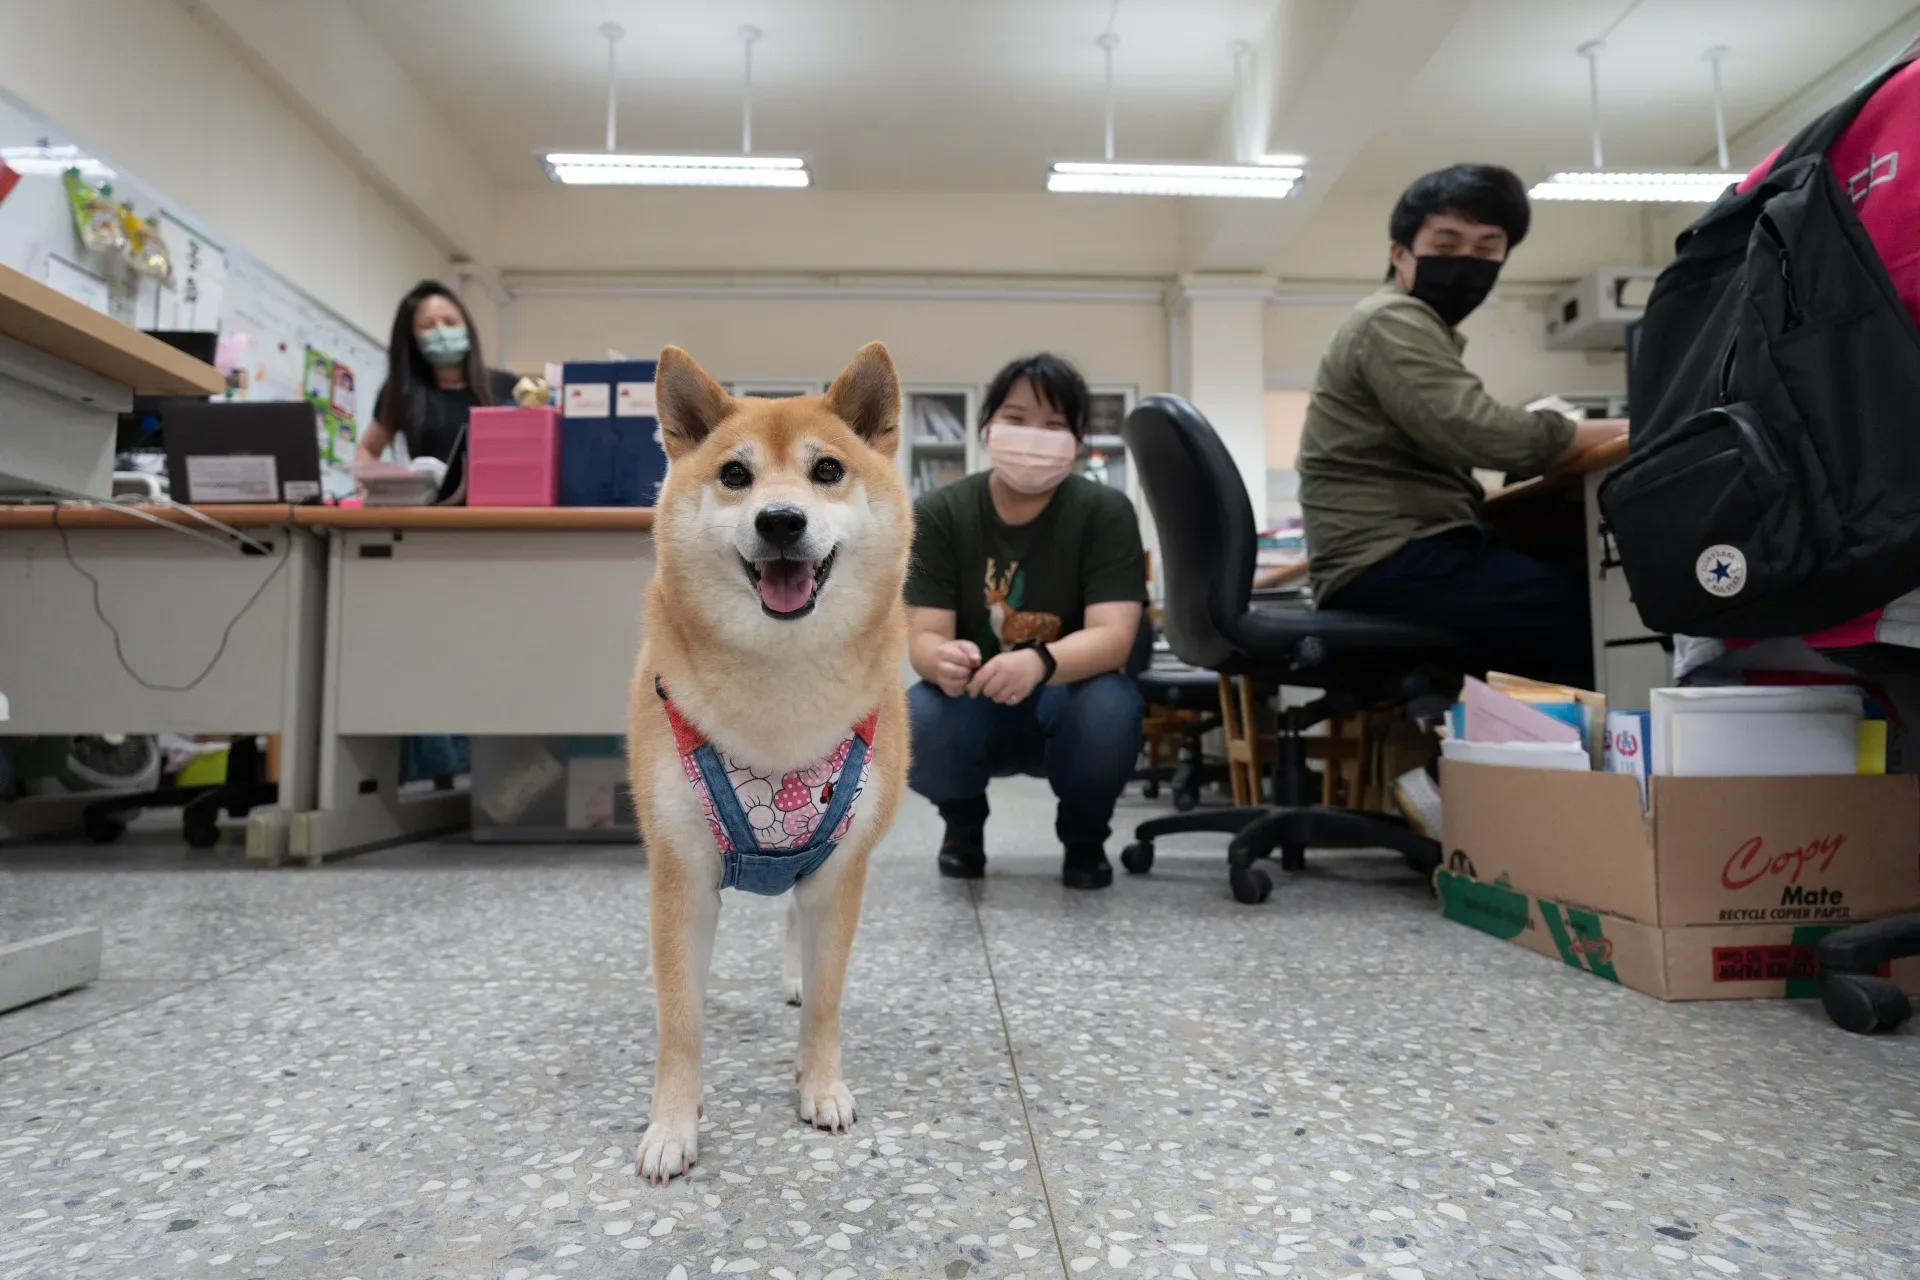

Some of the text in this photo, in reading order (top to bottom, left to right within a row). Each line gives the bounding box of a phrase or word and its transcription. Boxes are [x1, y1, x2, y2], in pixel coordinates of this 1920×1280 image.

[1721, 833, 1847, 890] Copy
[1780, 886, 1843, 905] Mate
[1719, 906, 1850, 921] RECYCLE COPIER PAPER
[1719, 965, 1761, 980] PAPER
